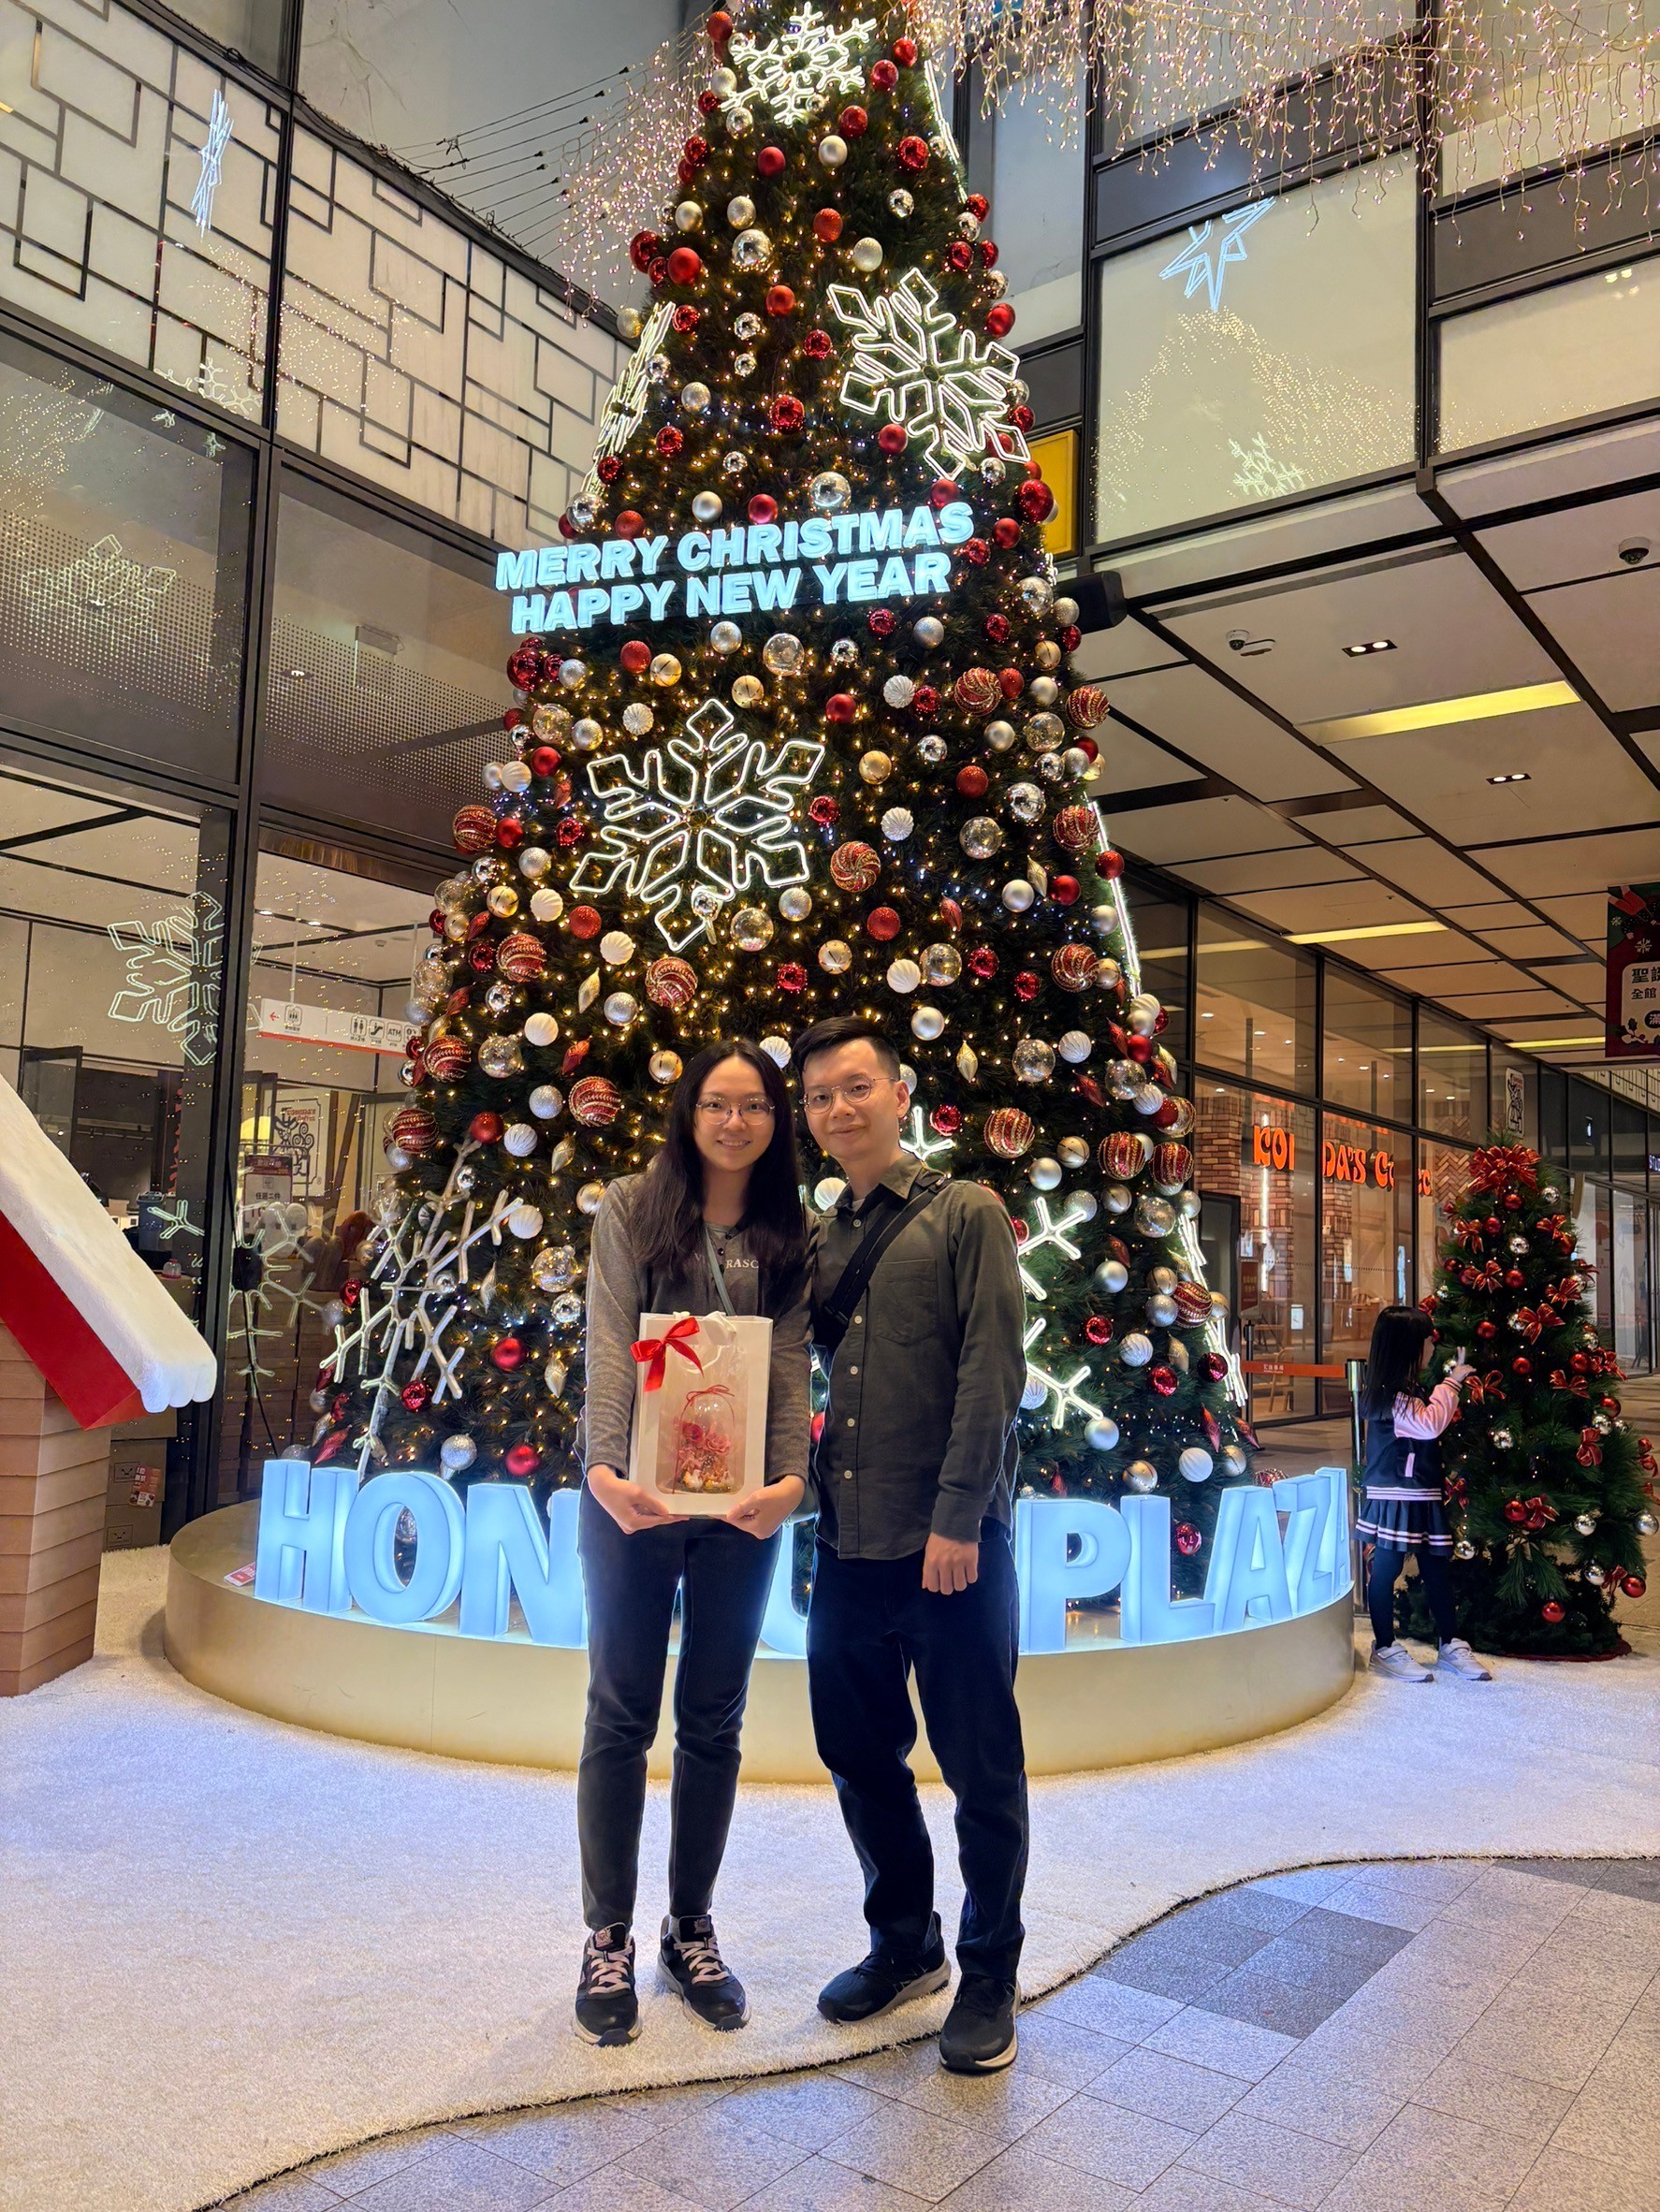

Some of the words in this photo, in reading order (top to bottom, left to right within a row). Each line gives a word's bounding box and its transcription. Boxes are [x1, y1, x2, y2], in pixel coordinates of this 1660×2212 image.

[495, 534, 669, 591] MERRY
[677, 502, 975, 573] CHRISTMAS
[511, 579, 677, 635] HAPPY
[686, 566, 802, 618] NEW
[811, 552, 952, 604] YEAR
[1631, 987, 1657, 1000] 全館
[387, 1028, 401, 1038] ATM
[1253, 1125, 1366, 1185] KODA'S
[1015, 1466, 1351, 1654] PLAZA
